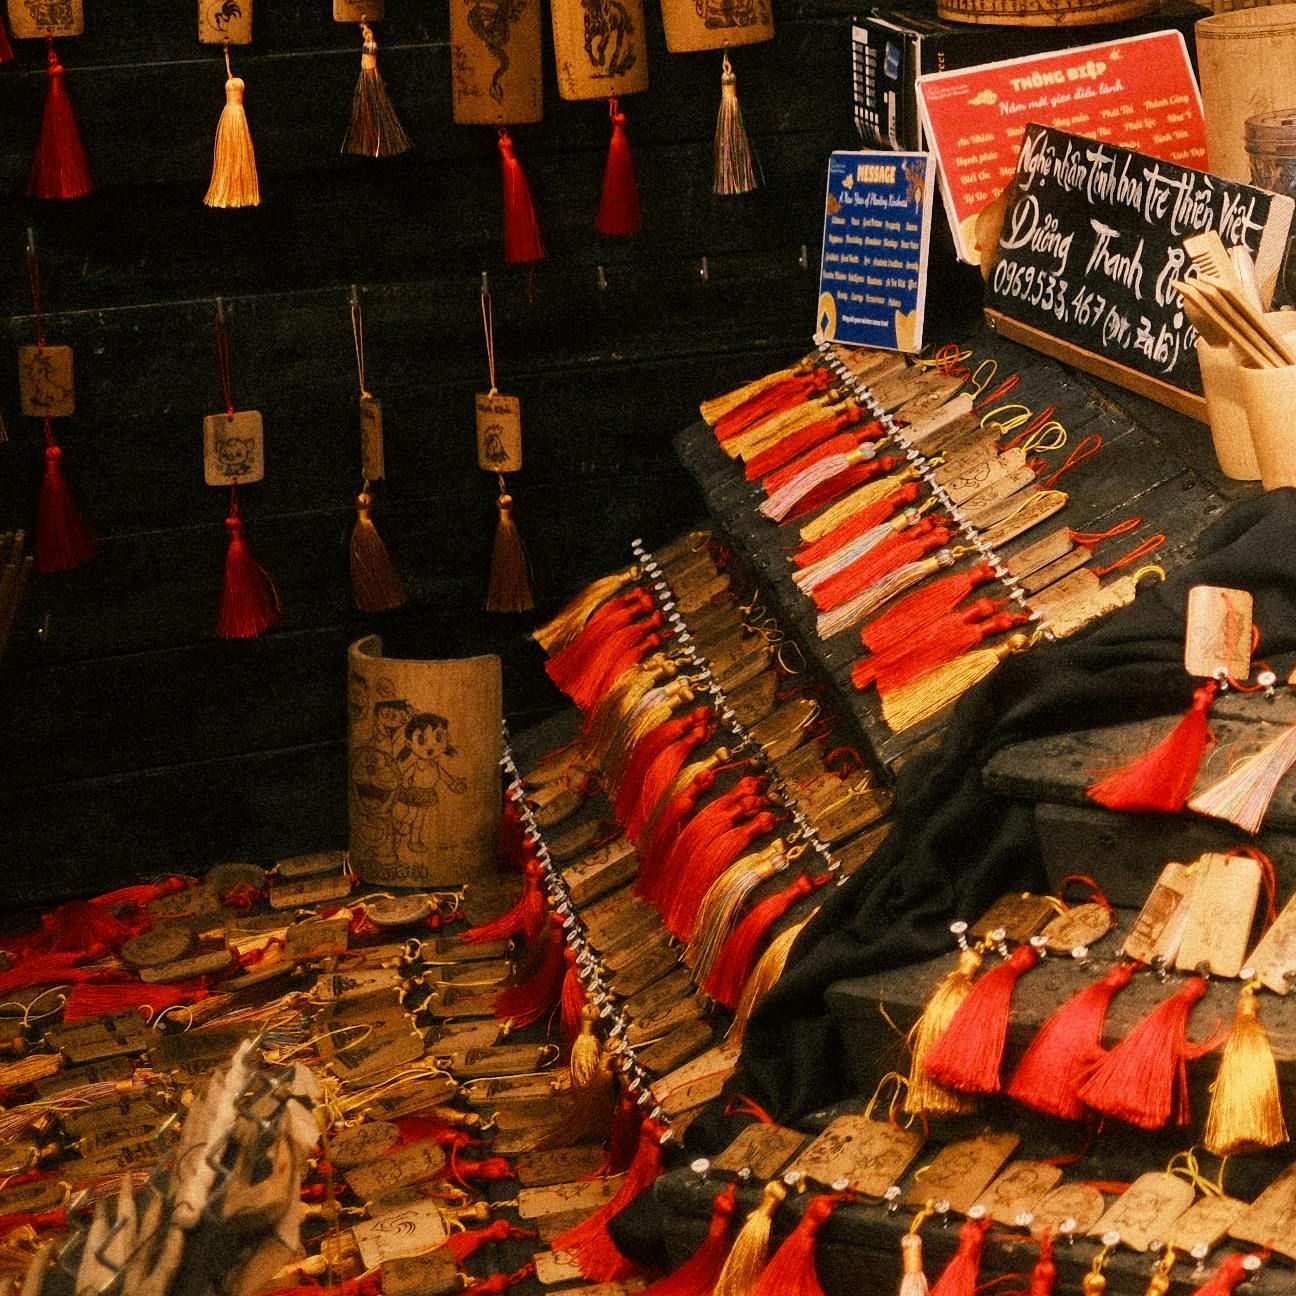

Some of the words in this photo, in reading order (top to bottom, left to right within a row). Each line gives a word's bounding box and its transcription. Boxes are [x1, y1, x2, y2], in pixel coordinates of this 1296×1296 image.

[1010, 65, 1066, 93] THÔNG
[856, 164, 897, 184] MESSAGE
[1017, 129, 1056, 191] Nghệ
[1053, 140, 1087, 192] nhân
[1116, 154, 1143, 213] hoa
[1143, 163, 1172, 225] tre
[1085, 218, 1145, 300] Thanh
